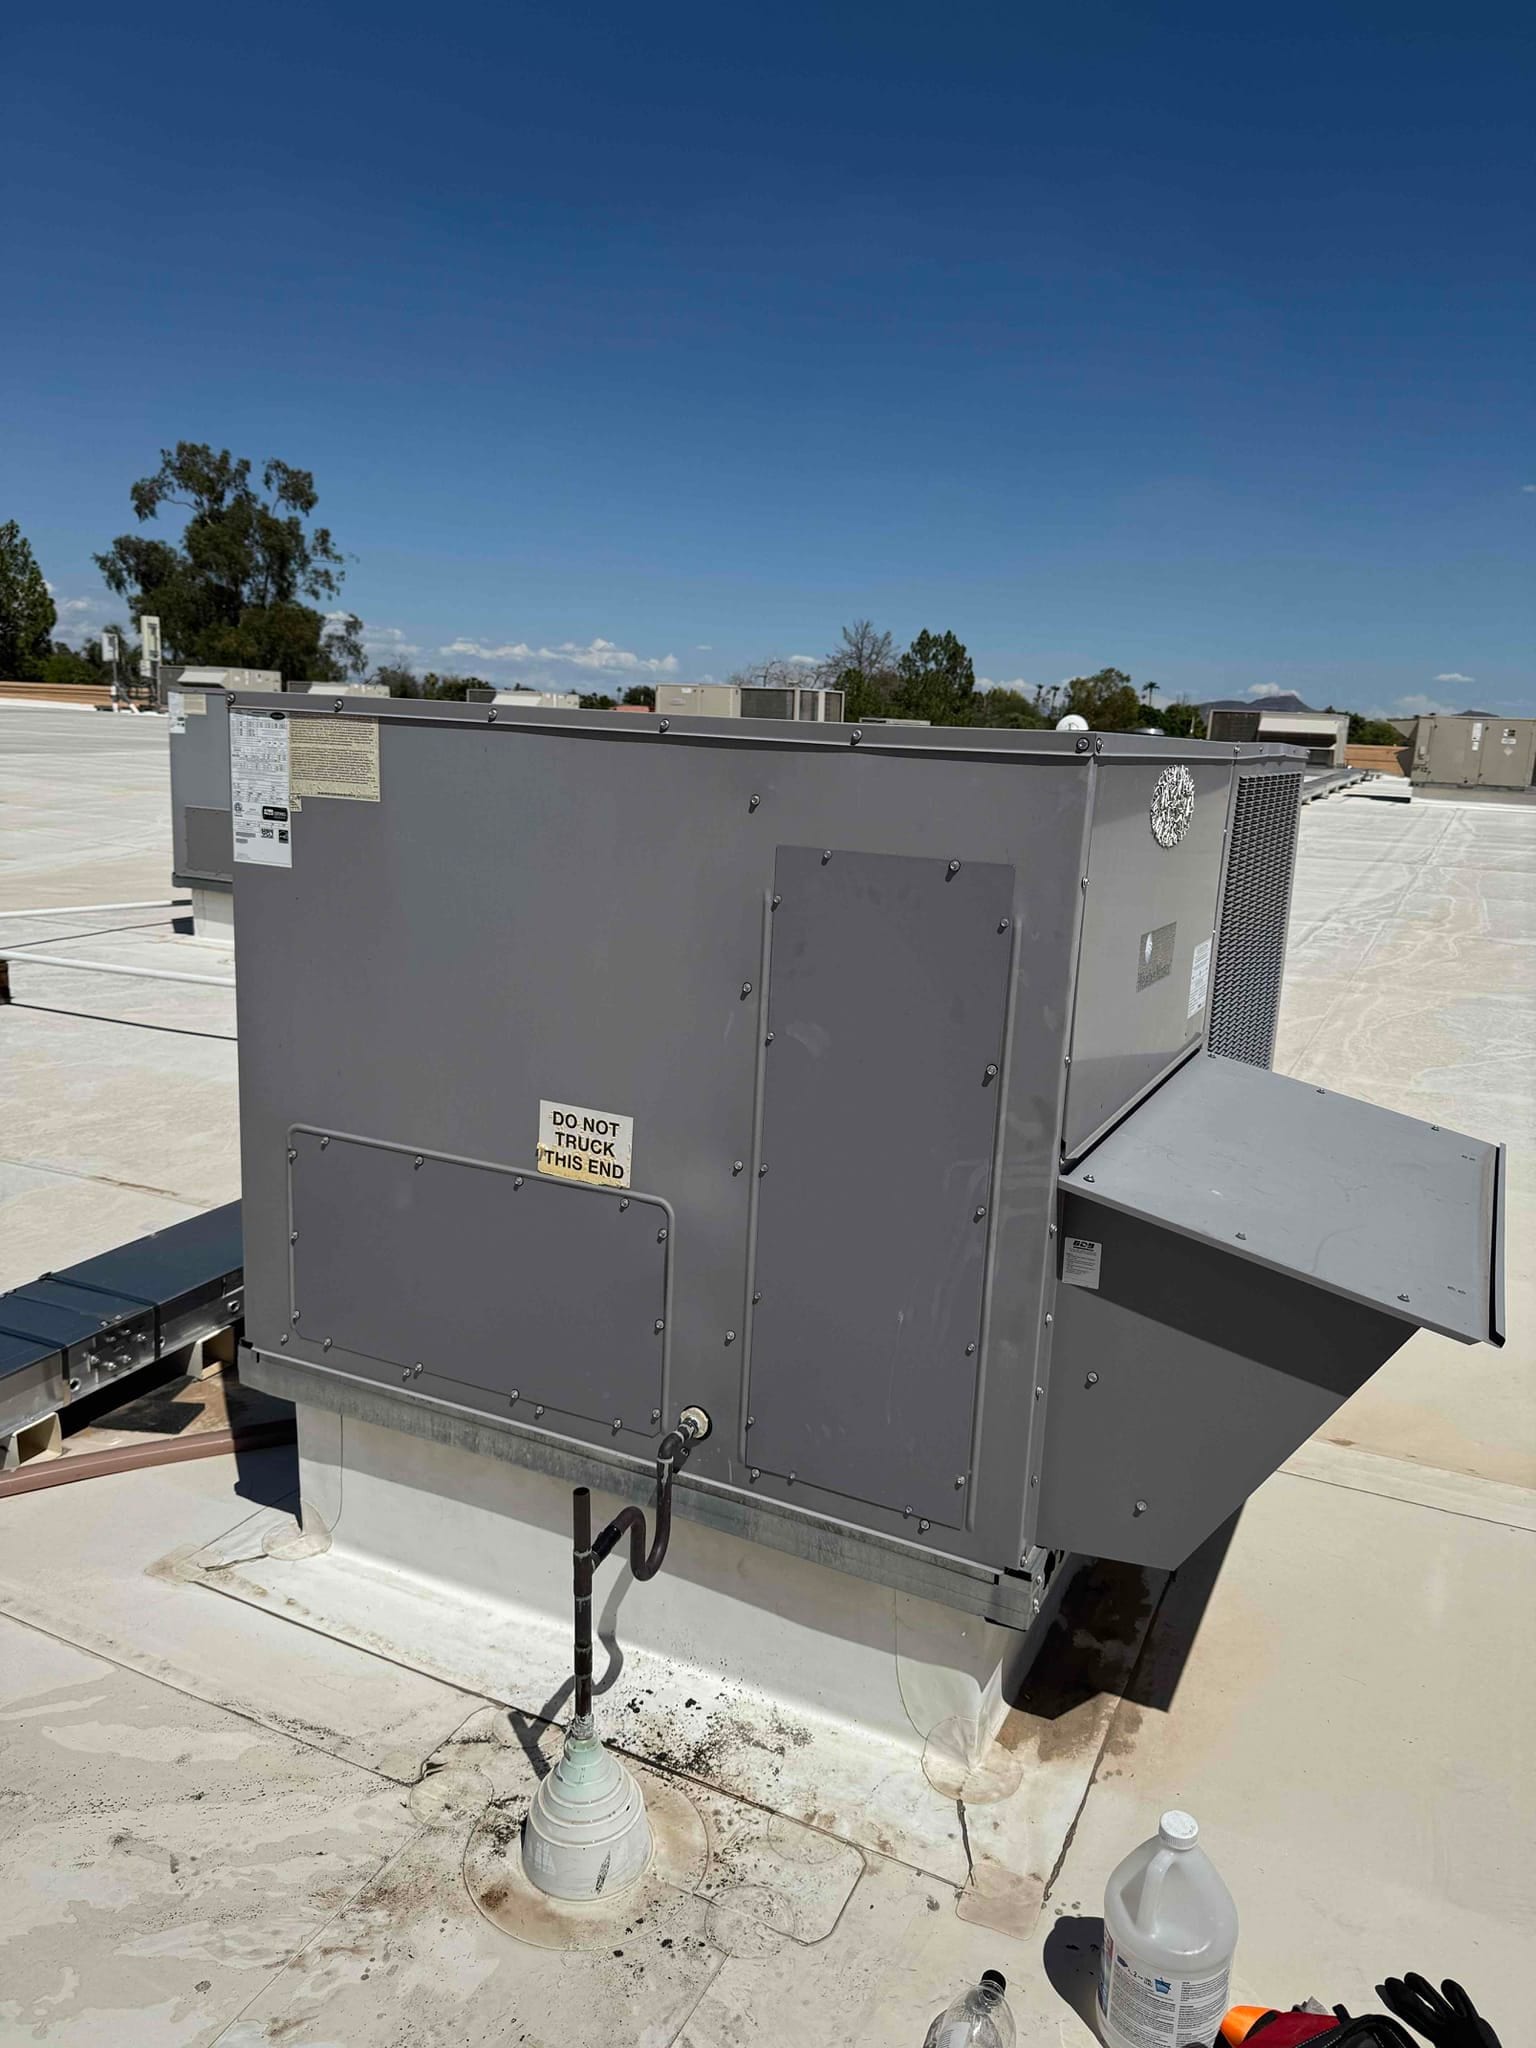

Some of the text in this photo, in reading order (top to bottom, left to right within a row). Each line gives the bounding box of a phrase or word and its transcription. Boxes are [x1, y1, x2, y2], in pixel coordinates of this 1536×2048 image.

[552, 1111, 620, 1137] DO NOT
[555, 1132, 615, 1157] TRUCK
[545, 1149, 624, 1179] THIS END
